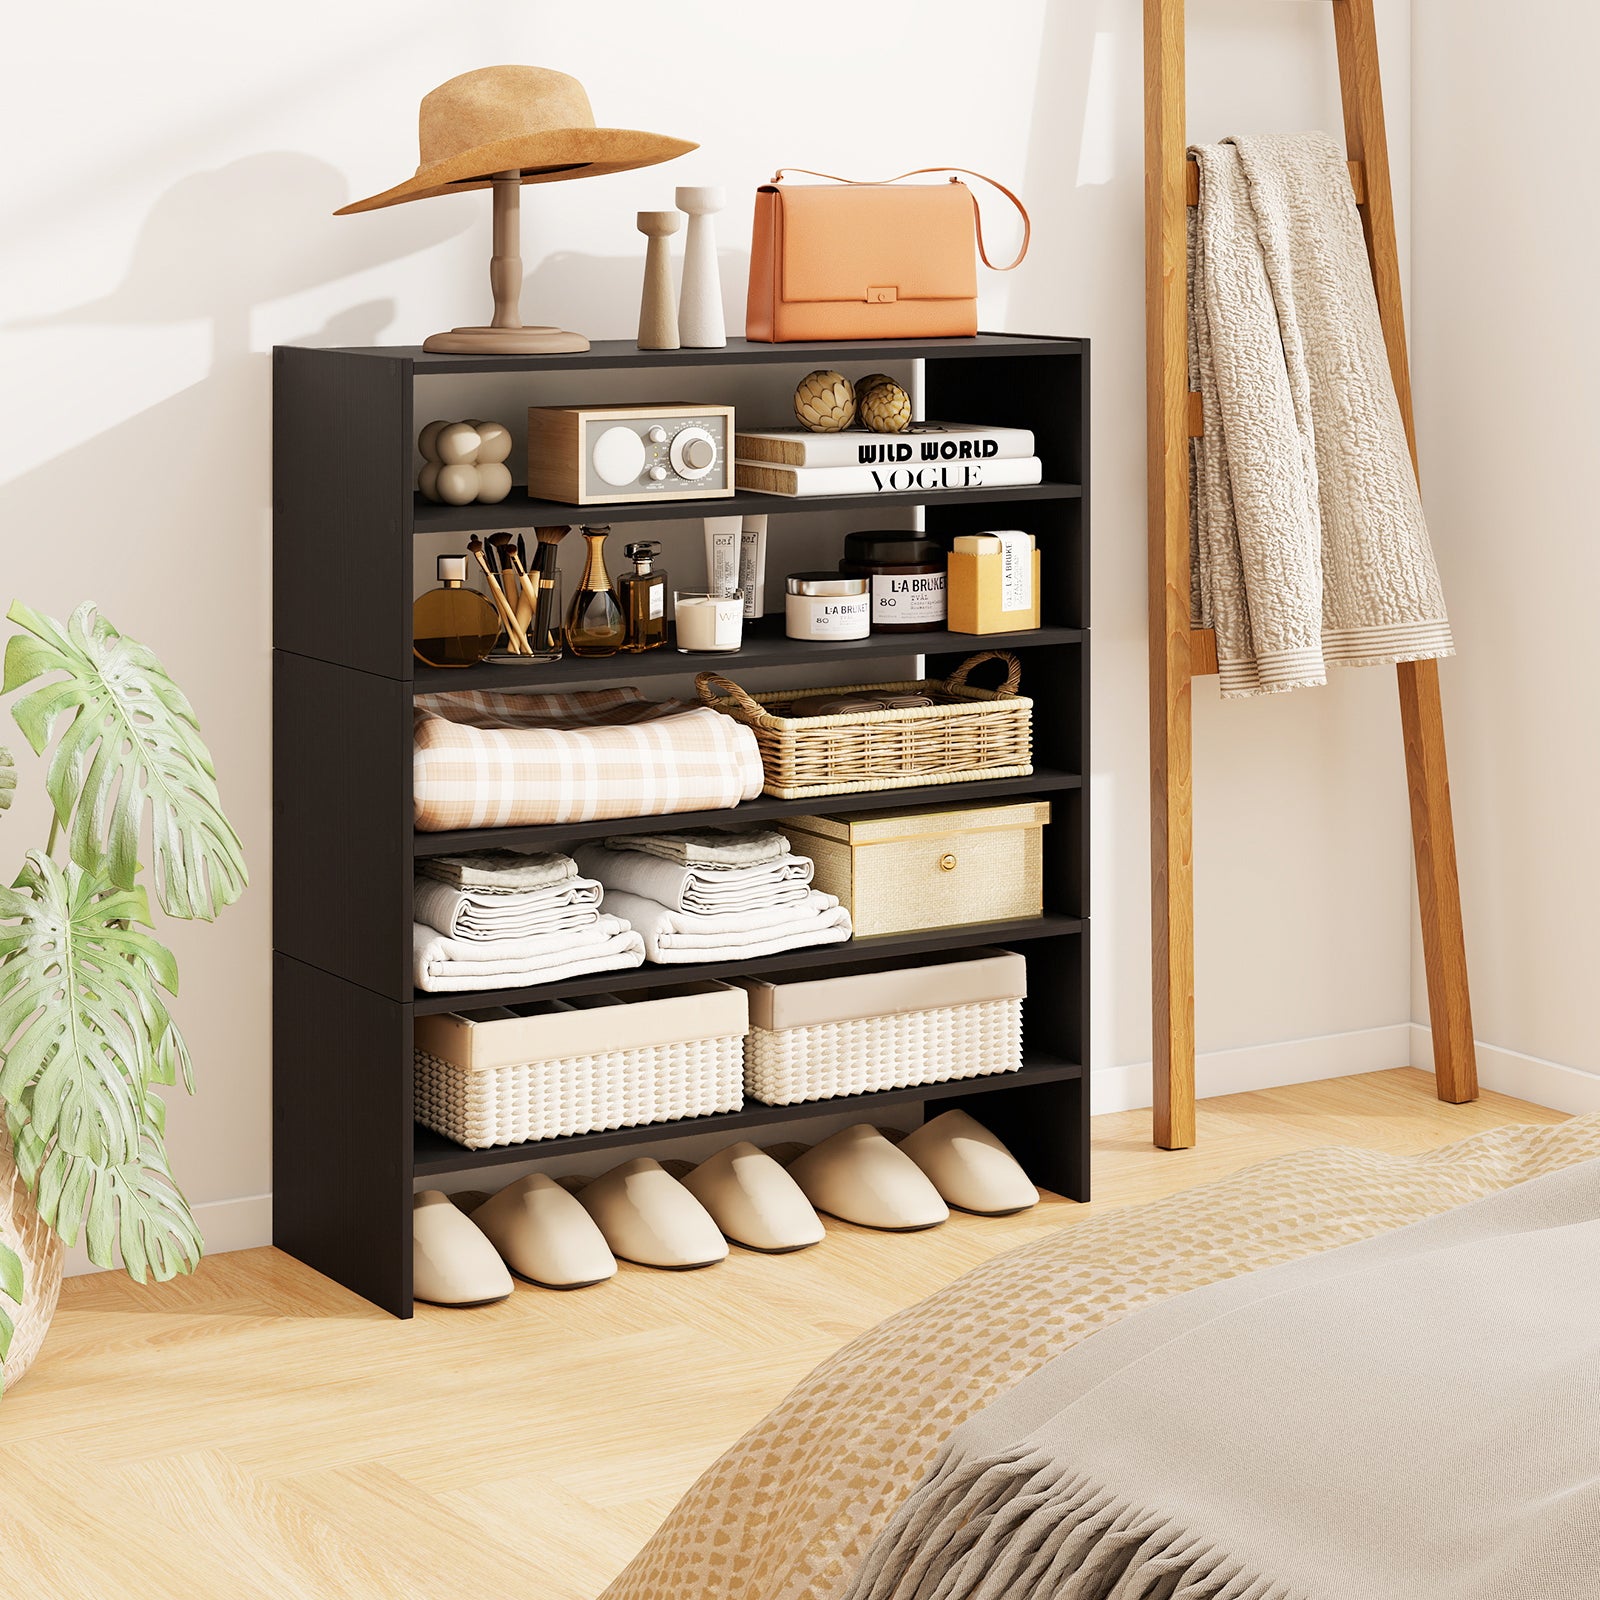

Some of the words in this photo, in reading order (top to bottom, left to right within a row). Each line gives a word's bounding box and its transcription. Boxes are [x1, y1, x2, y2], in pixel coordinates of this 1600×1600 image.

[858, 444, 912, 464] WILD
[920, 440, 999, 461] WORLD
[871, 466, 983, 492] VOGUE
[892, 580, 909, 592] L:A
[880, 598, 896, 607] 80
[825, 606, 839, 615] L:A
